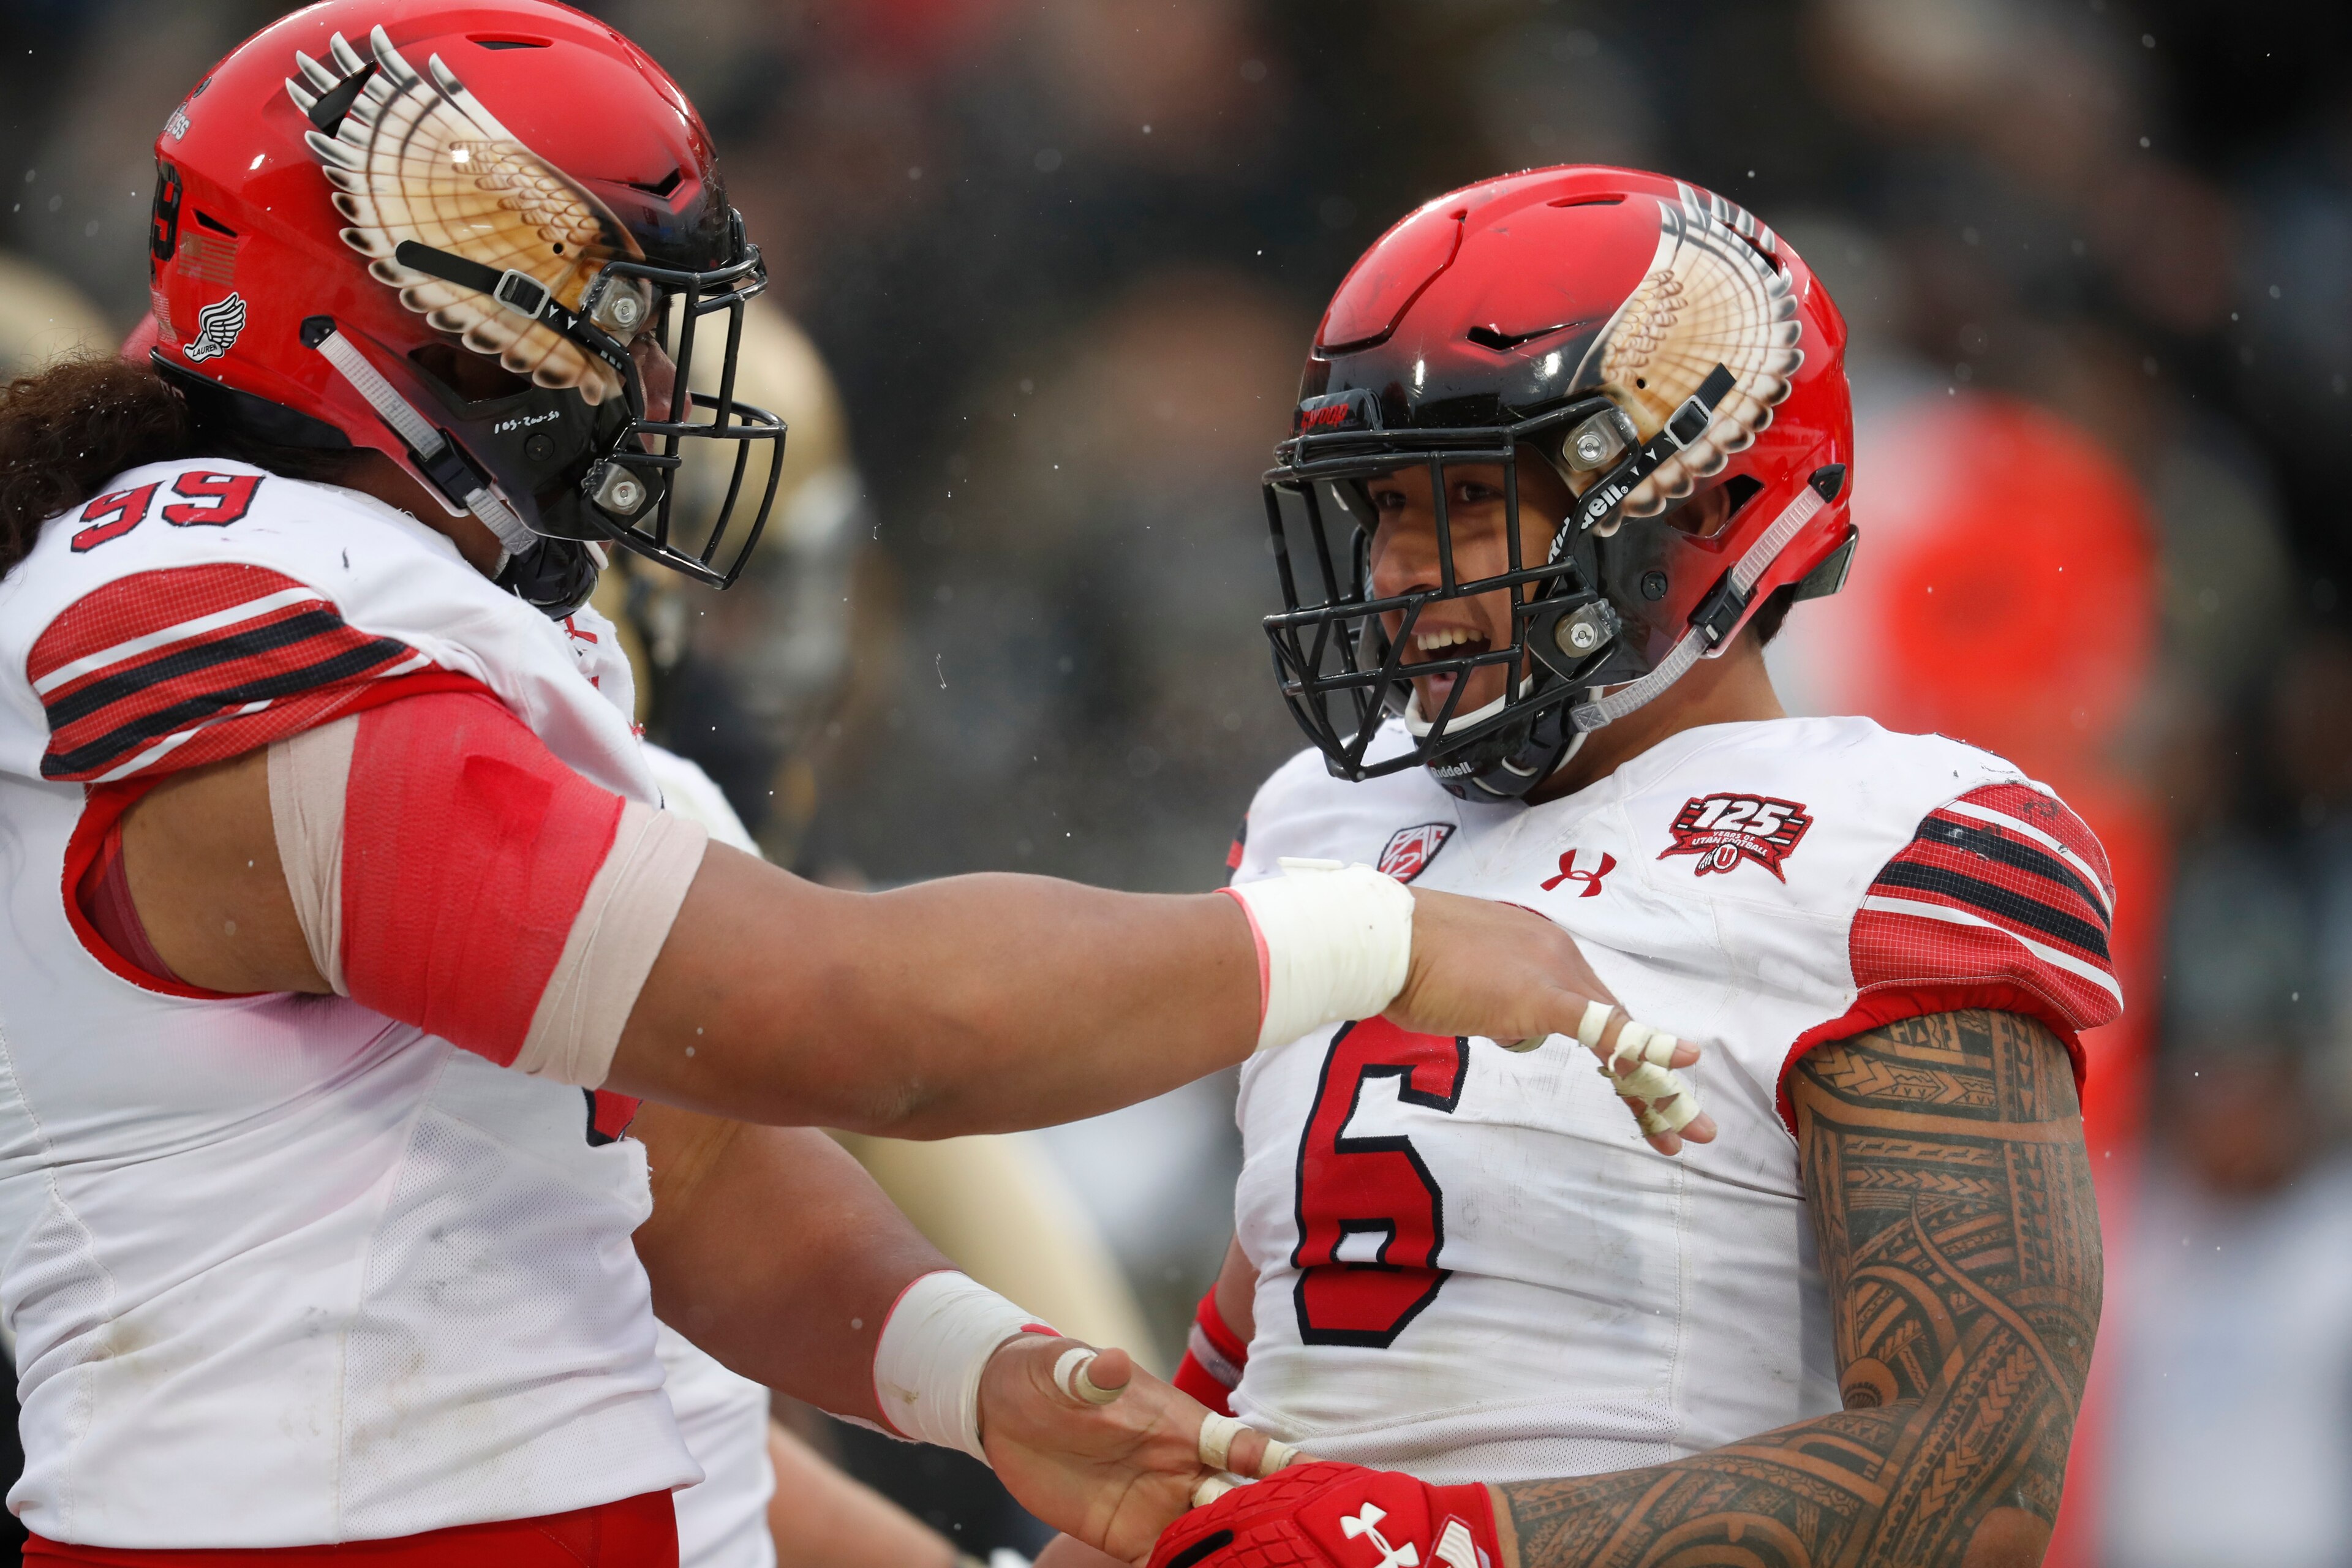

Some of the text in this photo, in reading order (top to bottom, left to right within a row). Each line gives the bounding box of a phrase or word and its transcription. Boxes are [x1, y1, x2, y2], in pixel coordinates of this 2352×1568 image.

[192, 343, 218, 357] LAUREN
[70, 471, 266, 553] 99
[1430, 761, 1472, 778] Riddell
[1692, 799, 1794, 837] 125
[1381, 825, 1450, 868] PAC
[1692, 837, 1768, 856] UTAH FOOTBALL
[1714, 831, 1741, 840] YEARS
[1384, 852, 1420, 877] 12
[1716, 848, 1736, 866] U
[1291, 1015, 1470, 1349] 6
